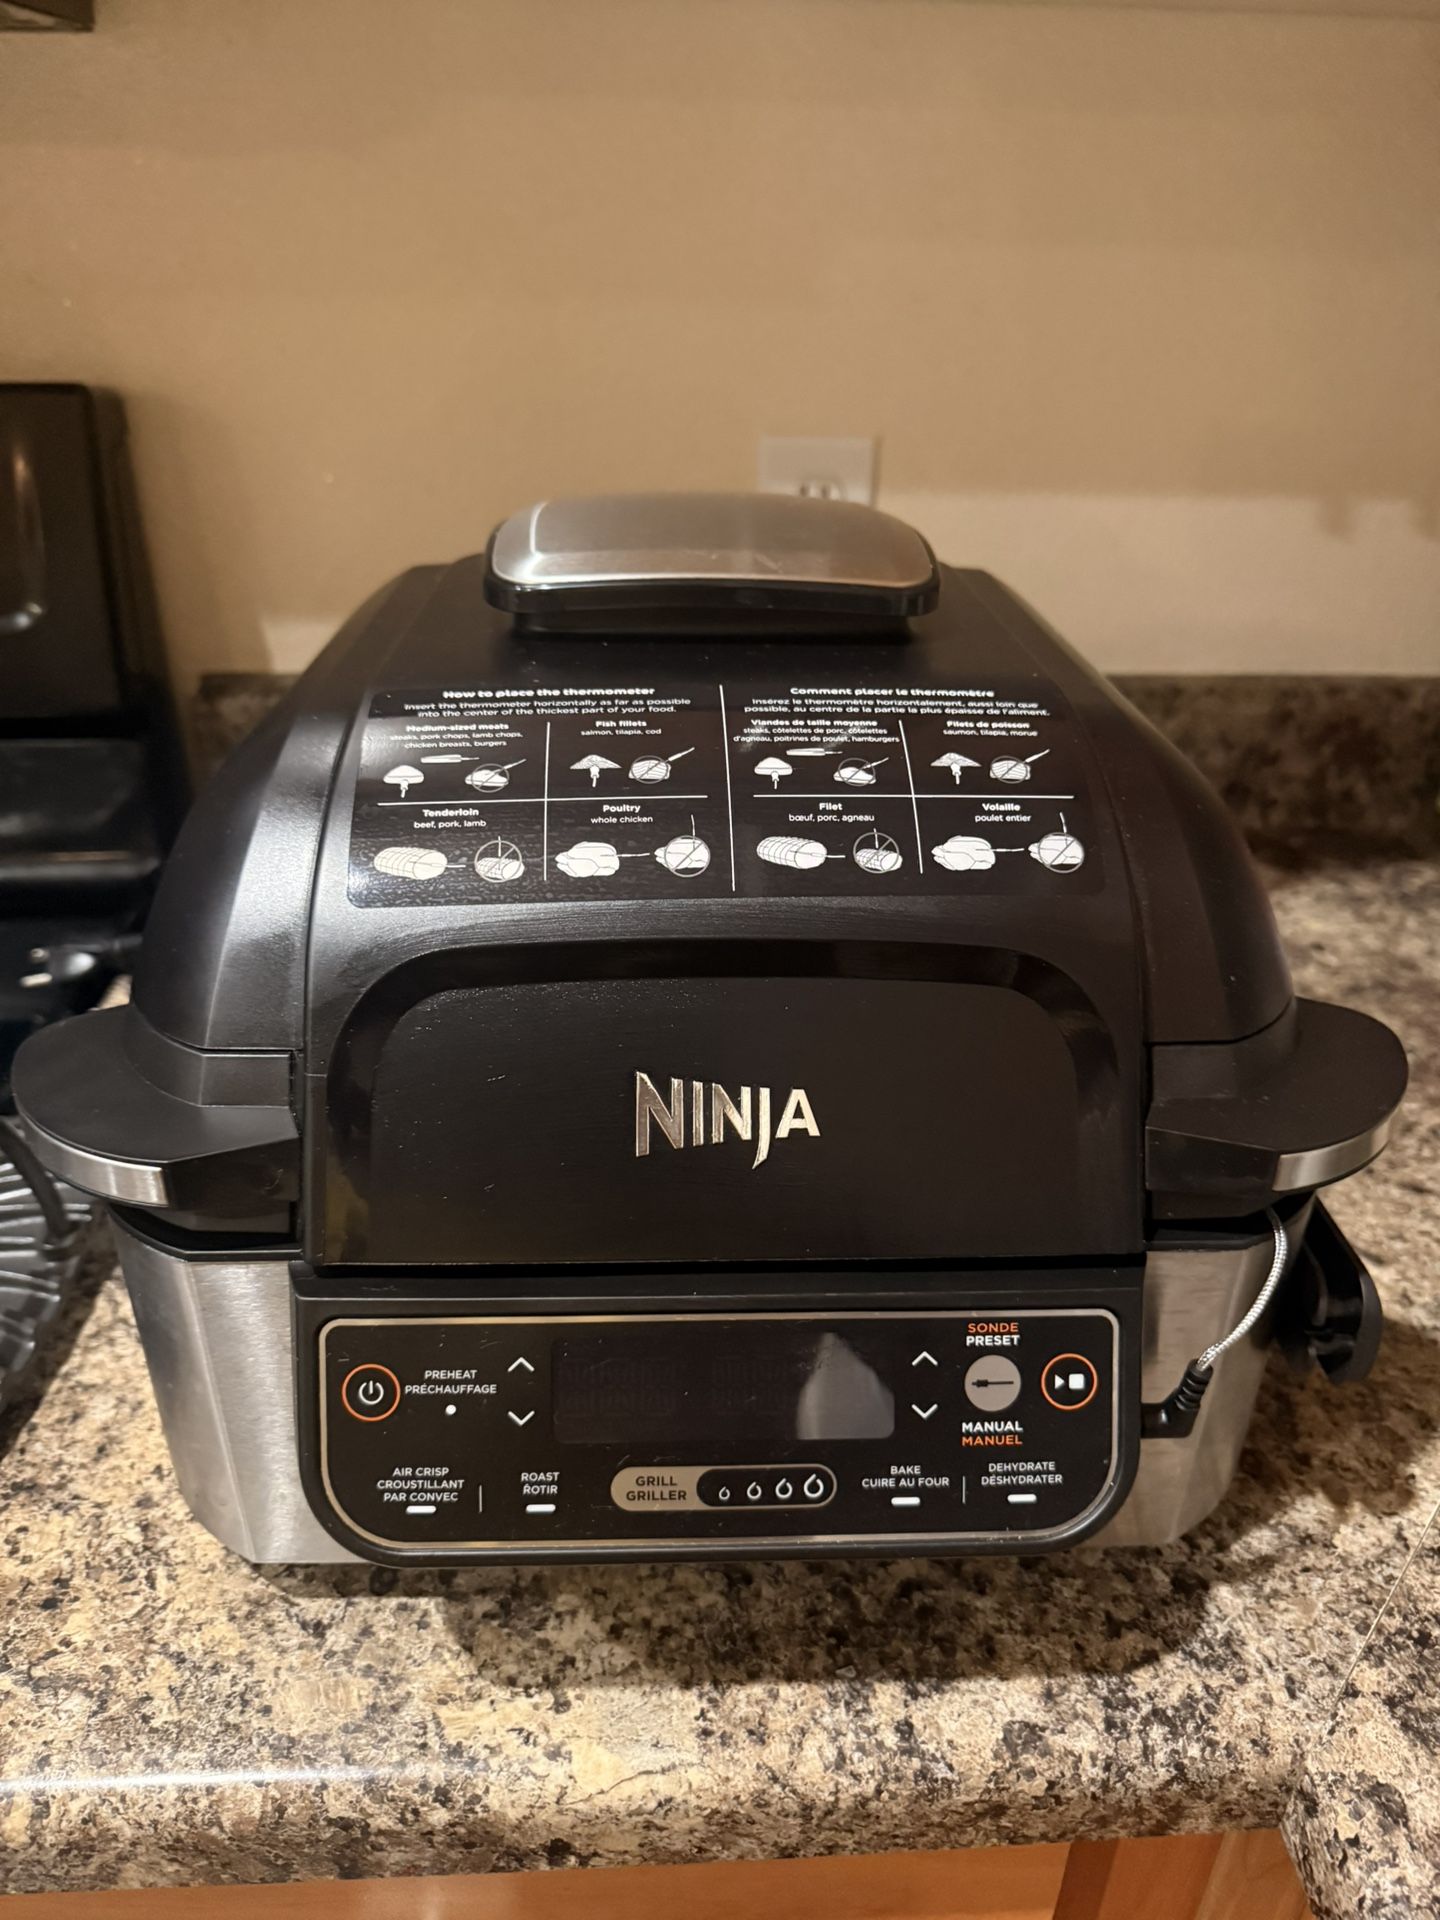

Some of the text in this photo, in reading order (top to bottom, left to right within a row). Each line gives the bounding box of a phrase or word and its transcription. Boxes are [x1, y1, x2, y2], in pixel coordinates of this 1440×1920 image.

[478, 690, 493, 698] to
[495, 689, 534, 698] place
[911, 689, 994, 697] thermomètre
[945, 707, 984, 715] épaisse
[406, 724, 476, 732] Medium-sized
[603, 804, 641, 813] Poultry
[819, 802, 842, 811] Filet
[982, 803, 1020, 811] Volaille
[423, 808, 479, 818] Tenderloin
[789, 814, 875, 823] bœuf, porc, agneau
[975, 814, 1003, 823] poulet
[414, 819, 486, 829] beef, pork, lamb
[591, 815, 653, 824] whole chicken
[635, 1070, 821, 1169] NINJA
[967, 1322, 1019, 1333] SONDE
[966, 1334, 1020, 1347] PRESET
[424, 1369, 477, 1380] PREHEAT
[405, 1383, 497, 1395] PRÉCHAUFFAGE
[961, 1421, 1023, 1433] MANUAL
[961, 1434, 1023, 1446] MANUEL
[392, 1467, 449, 1477] AIR CRISP
[890, 1465, 921, 1475] BAKE
[988, 1462, 1055, 1473] DEHYDRATE
[521, 1472, 560, 1483] ROAST
[635, 1475, 677, 1487] GRILL
[862, 1476, 949, 1488] CUIRE AU FOUR
[981, 1474, 1063, 1486] DÉSHYDRATER
[377, 1479, 464, 1490] CROUSTILLANT
[384, 1491, 458, 1502] PAR CONVEC
[626, 1490, 687, 1501] GRILLER
